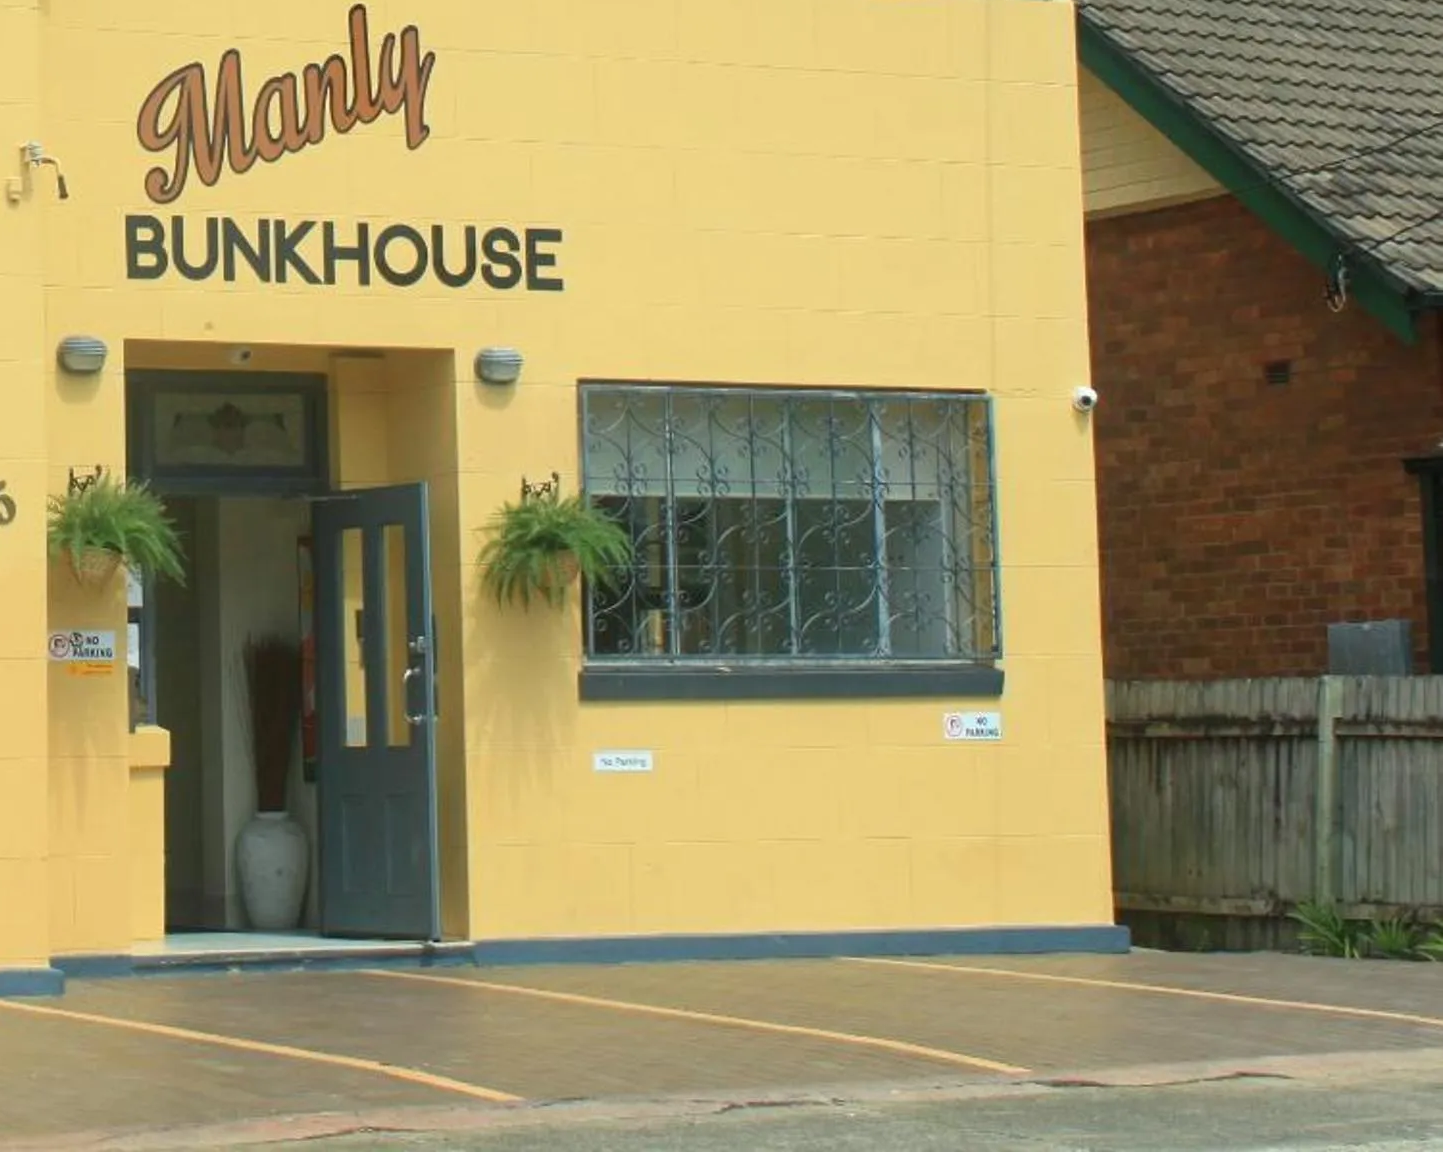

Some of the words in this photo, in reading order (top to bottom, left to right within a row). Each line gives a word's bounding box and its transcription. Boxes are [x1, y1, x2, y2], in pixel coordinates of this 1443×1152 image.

[136, 3, 436, 204] Manly
[125, 214, 564, 291] BUNKHOUSE
[85, 635, 100, 645] NO
[72, 647, 114, 658] PARKING
[976, 716, 988, 726] NO
[965, 728, 999, 737] PARKING
